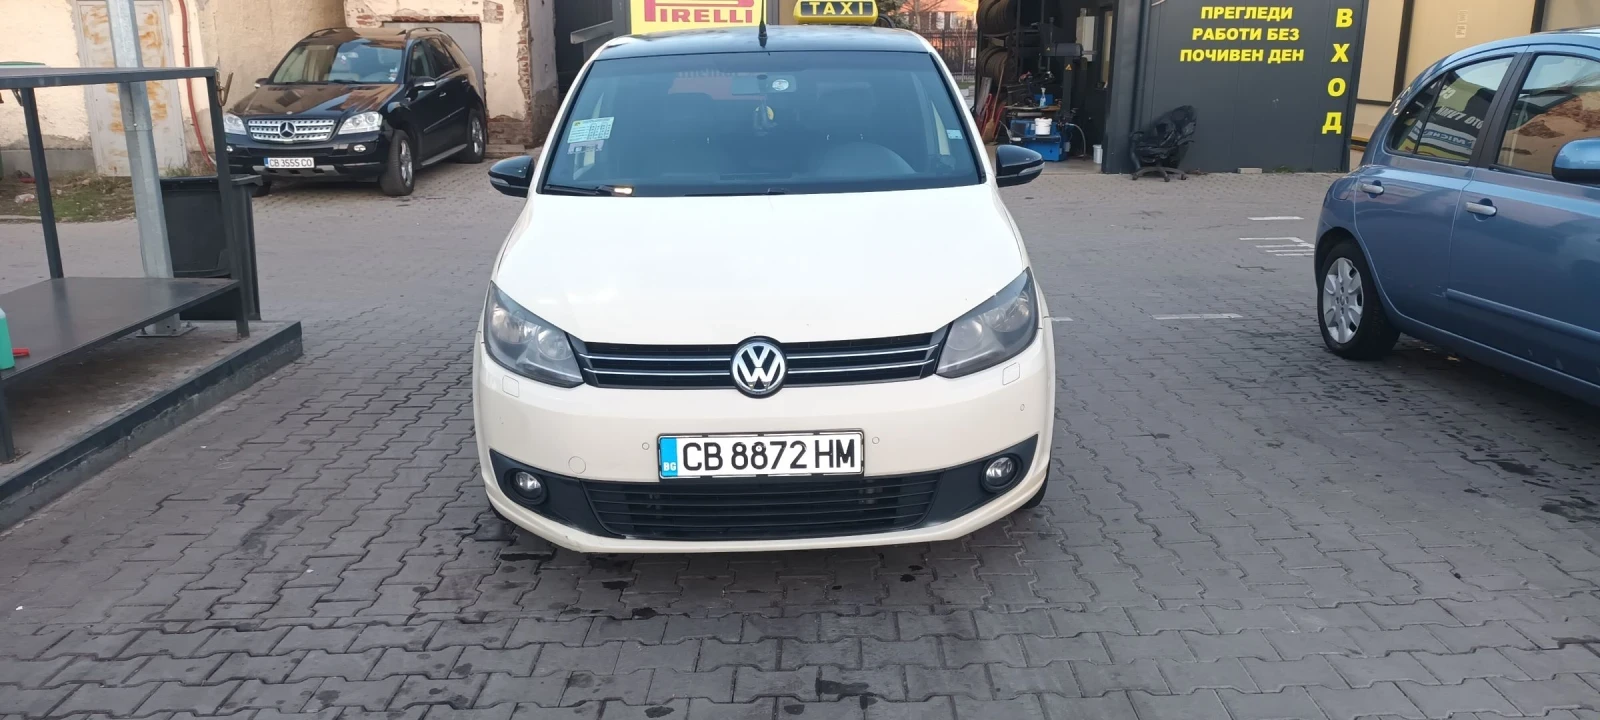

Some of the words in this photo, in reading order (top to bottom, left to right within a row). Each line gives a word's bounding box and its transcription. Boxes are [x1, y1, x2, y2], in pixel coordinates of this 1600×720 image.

[644, 0, 754, 23] PIRELLI
[809, 1, 864, 15] TAXI
[1200, 6, 1293, 22] ПРЕГЛЕДИ
[1192, 27, 1262, 41] РАБОТИ
[1266, 28, 1300, 41] БЕЗ
[1179, 49, 1264, 62] ПОЧИВЕН
[1267, 49, 1304, 64] ДЕН
[1322, 8, 1354, 134] ВХОД
[269, 159, 280, 167] CB
[281, 159, 300, 167] 3555
[682, 442, 724, 471] CB
[731, 440, 808, 470] 8872
[814, 439, 855, 469] HM
[663, 462, 677, 471] BG
